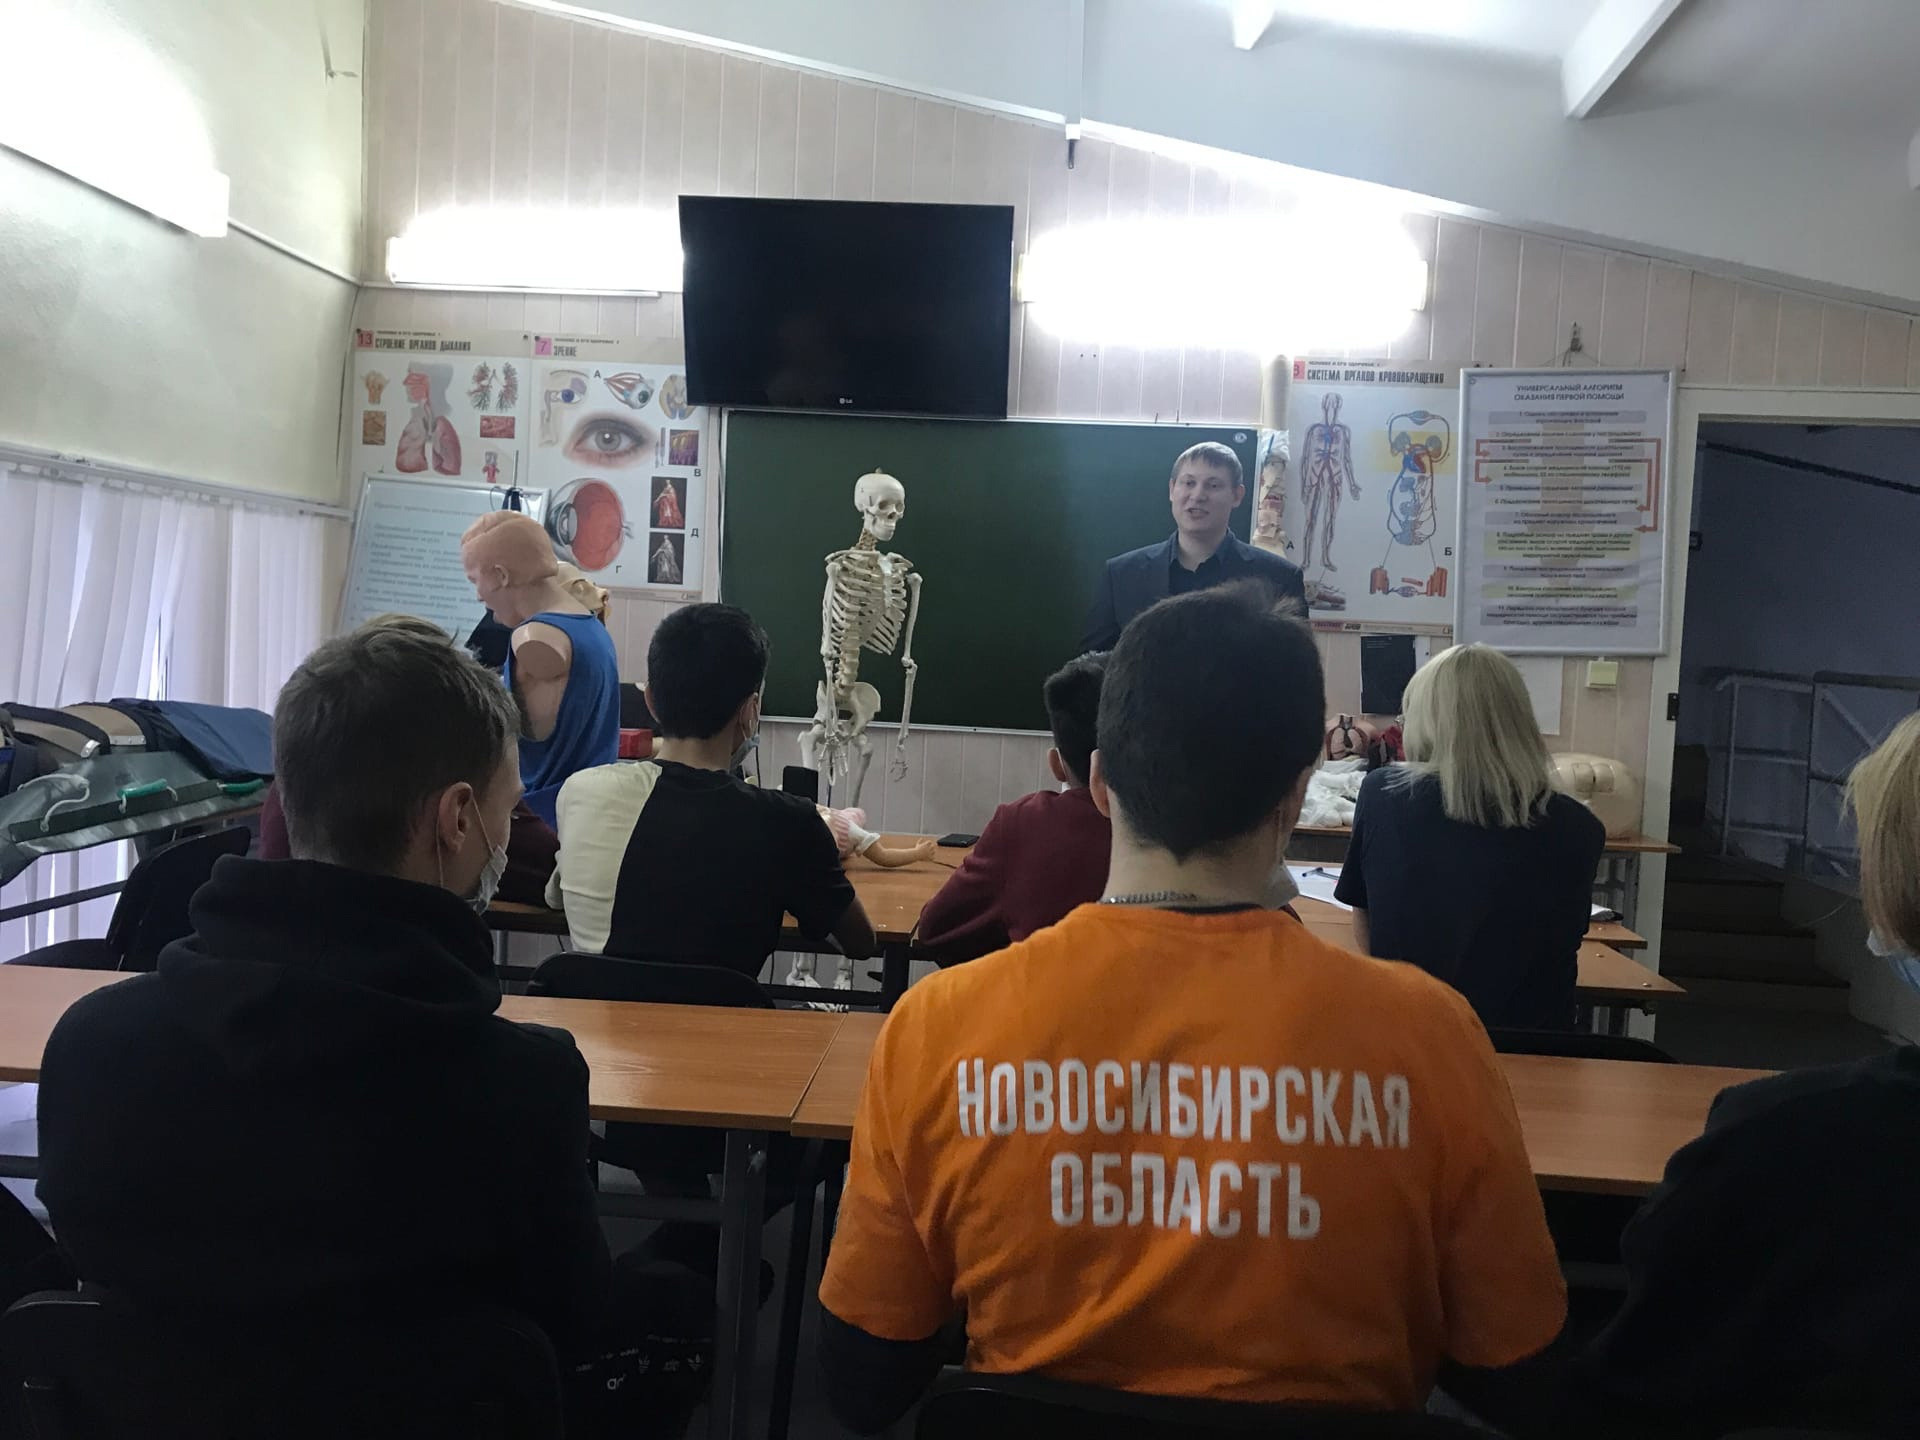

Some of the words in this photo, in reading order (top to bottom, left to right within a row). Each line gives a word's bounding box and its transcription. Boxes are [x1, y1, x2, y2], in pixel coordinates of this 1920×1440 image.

[359, 332, 372, 345] 13
[540, 341, 547, 352] 7
[553, 346, 577, 357] ЗРЕНИЕ
[1307, 369, 1341, 381] СИСТЕМА
[1344, 370, 1375, 382] ОРГАНОВ
[1378, 371, 1444, 384] КРОВООБРАЩЕНИЯ
[1556, 393, 1586, 401] ПЕРВОЙ
[1587, 393, 1625, 401] ПОМОЩИ
[957, 1057, 1411, 1149] НОВОСИБИРСКАЯ
[1050, 1152, 1321, 1241] ОБЛАСТЬ
